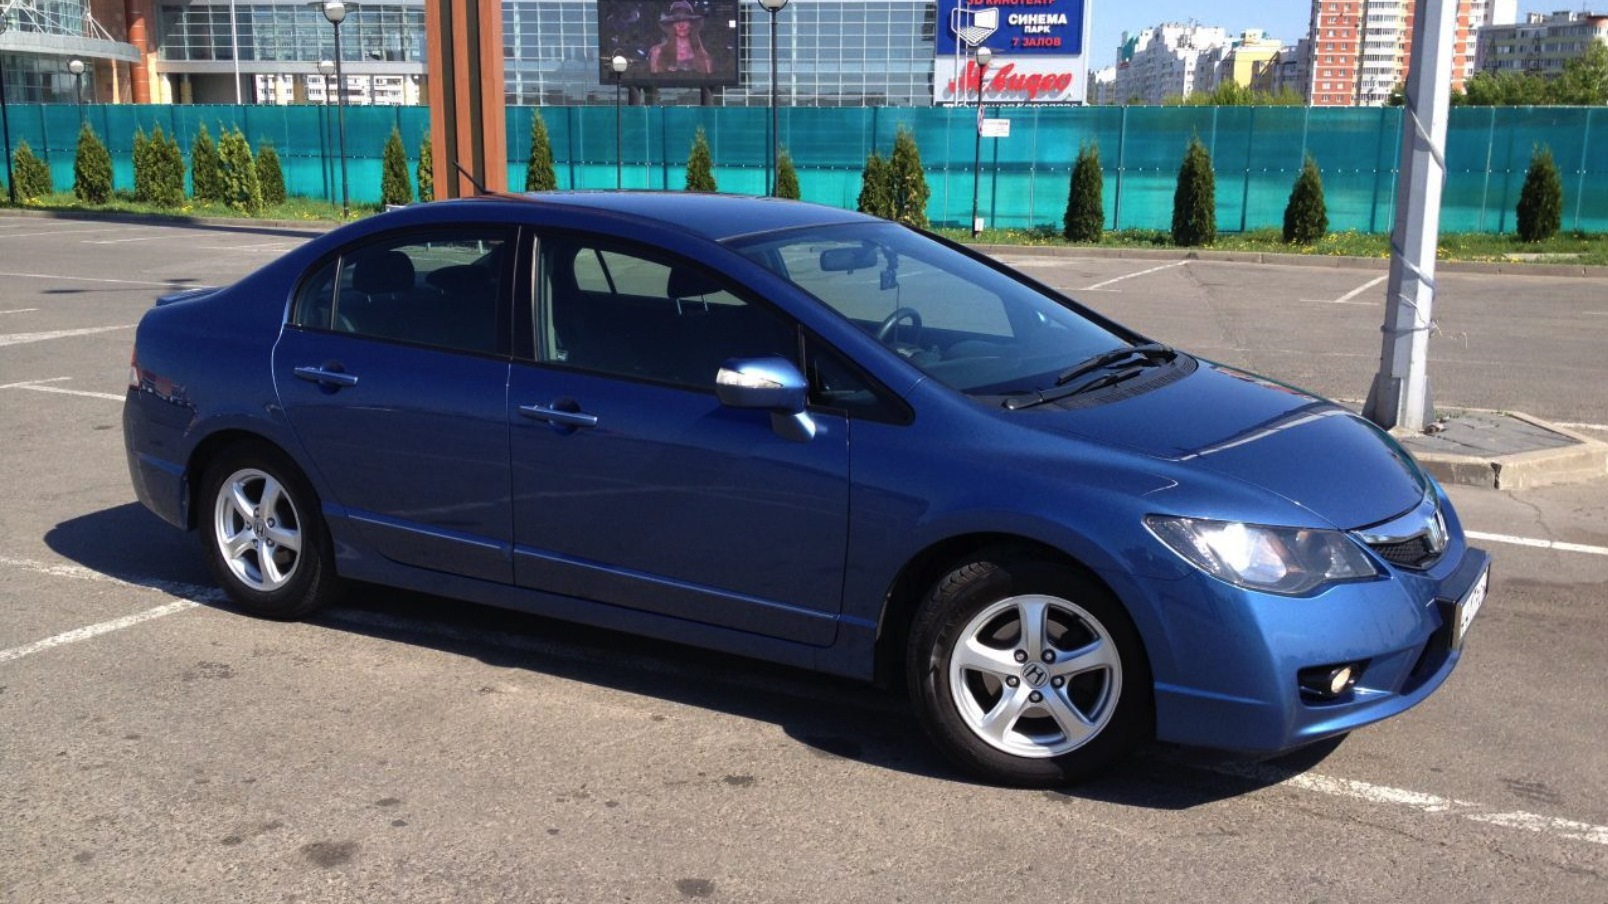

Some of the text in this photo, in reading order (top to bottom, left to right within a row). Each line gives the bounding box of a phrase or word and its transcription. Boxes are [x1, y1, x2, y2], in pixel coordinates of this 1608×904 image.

[1008, 13, 1067, 25] СИНЕМА
[1024, 25, 1050, 33] ПАРК
[1012, 37, 1061, 47] 7 ЗАЛОВ
